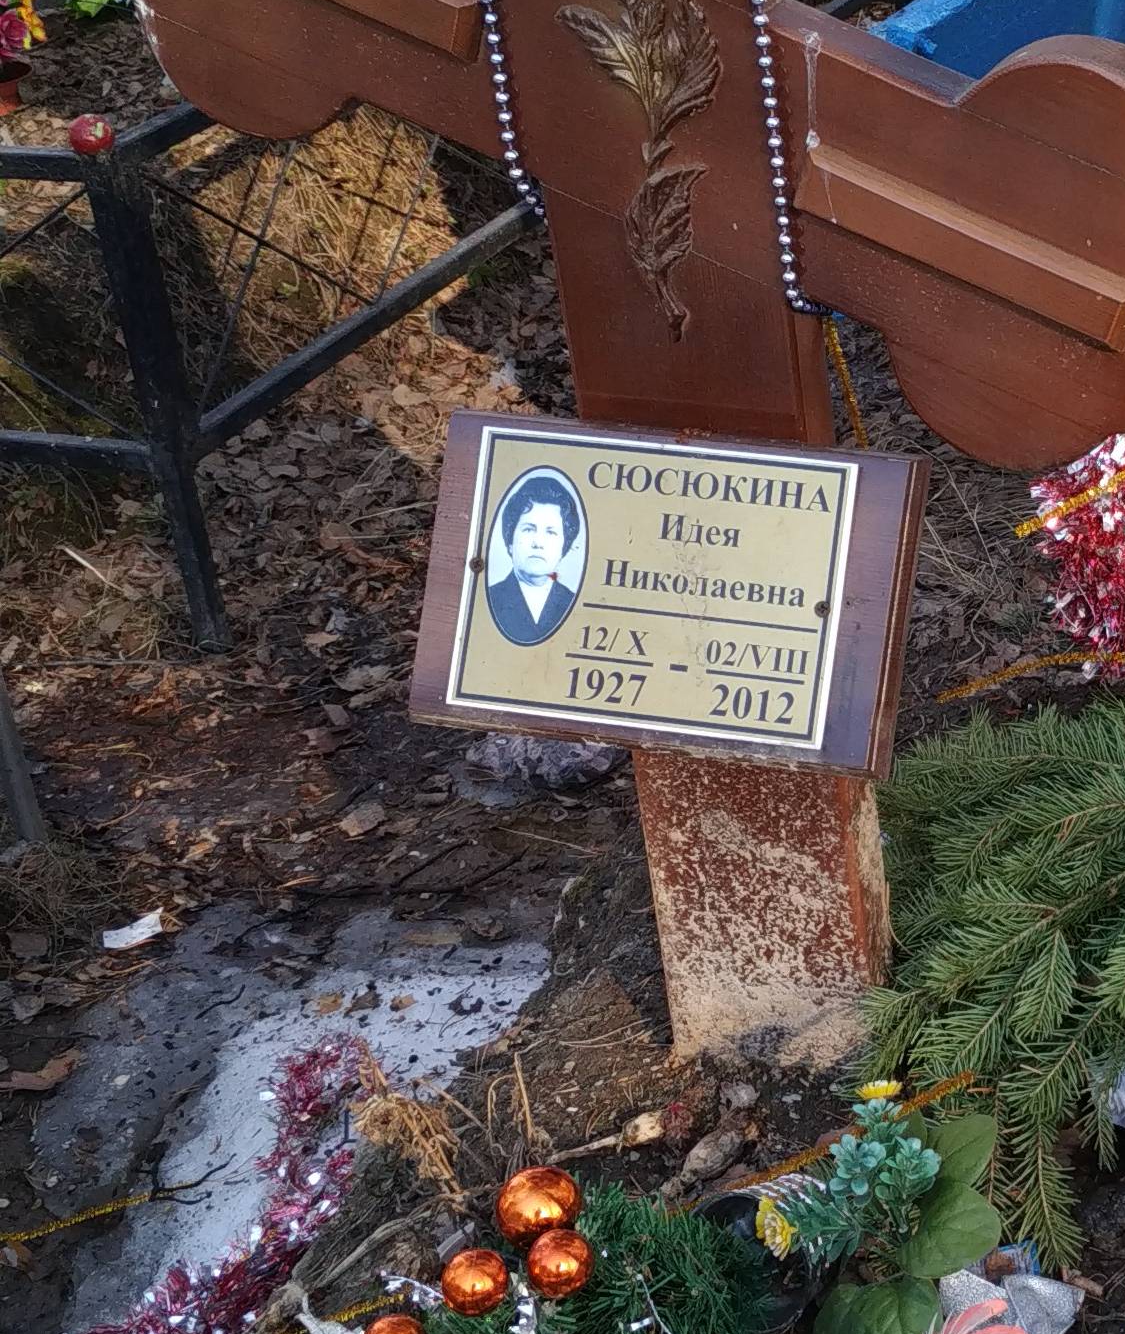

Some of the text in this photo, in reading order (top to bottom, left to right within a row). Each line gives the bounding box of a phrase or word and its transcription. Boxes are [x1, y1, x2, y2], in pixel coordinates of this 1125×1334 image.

[587, 460, 832, 514] СЮСЮКИНА
[657, 512, 742, 549] Идея
[600, 558, 806, 609] Николаевна
[705, 639, 812, 676] 02/VIII
[564, 666, 796, 725] 1927 2012
